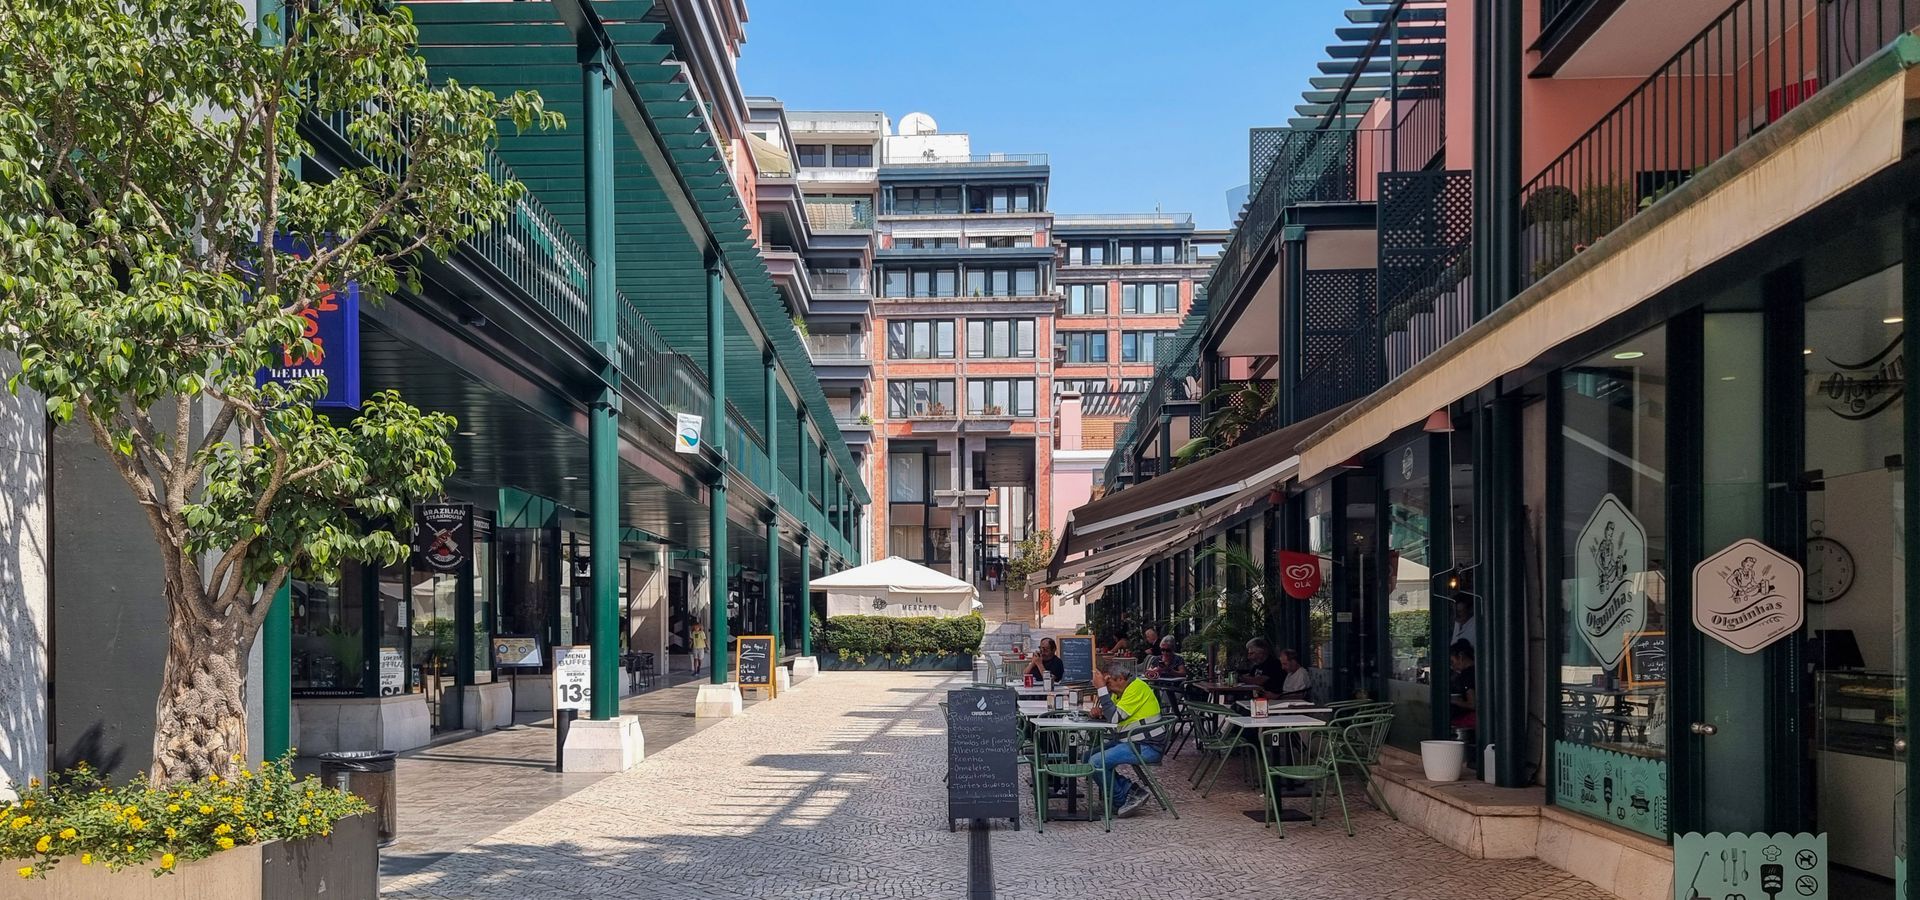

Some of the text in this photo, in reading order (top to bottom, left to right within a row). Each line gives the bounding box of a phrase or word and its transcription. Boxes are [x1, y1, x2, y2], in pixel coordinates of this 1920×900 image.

[423, 508, 466, 517] BRAZILIAN
[1585, 588, 1633, 634] Olguinhas
[1711, 601, 1783, 628] Olguinhas
